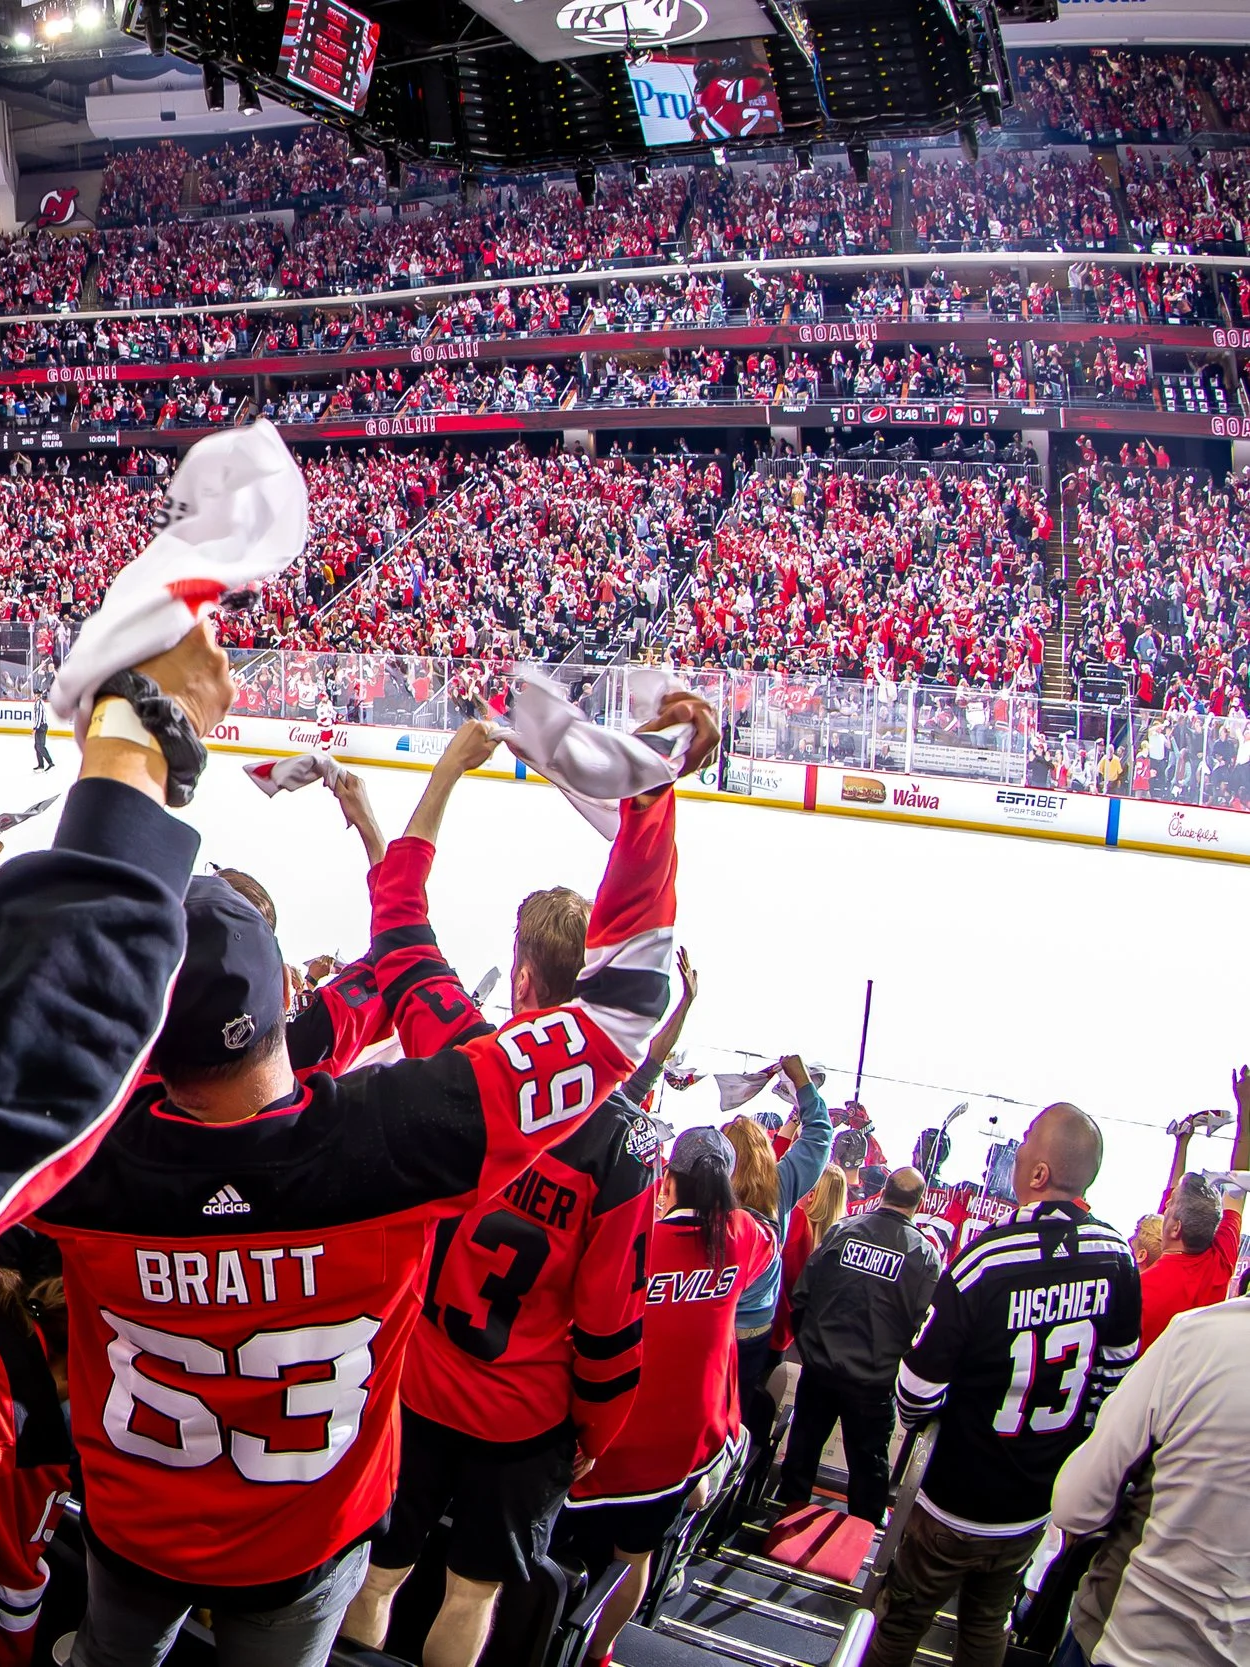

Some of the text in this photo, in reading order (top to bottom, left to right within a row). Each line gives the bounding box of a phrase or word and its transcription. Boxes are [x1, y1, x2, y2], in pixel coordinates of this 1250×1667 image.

[631, 79, 694, 120] Pru
[799, 323, 877, 342] GOAL!!!
[411, 342, 479, 362] GOAL!!!
[47, 366, 117, 382] GOAL!!!
[847, 409, 855, 420] 0
[973, 410, 981, 422] 0
[365, 416, 436, 436] GOAL!!!
[893, 789, 939, 810] Wawa
[1003, 807, 1058, 818] SPORTSBOOK
[497, 1011, 594, 1136] 63
[202, 1200, 251, 1215] adidas
[842, 1241, 901, 1277] SECURITY
[135, 1245, 325, 1306] BRATT
[644, 1266, 739, 1305] EVILS
[1007, 1278, 1110, 1330] HISCHIER
[992, 1319, 1098, 1437] 13
[100, 1307, 381, 1485] 63
